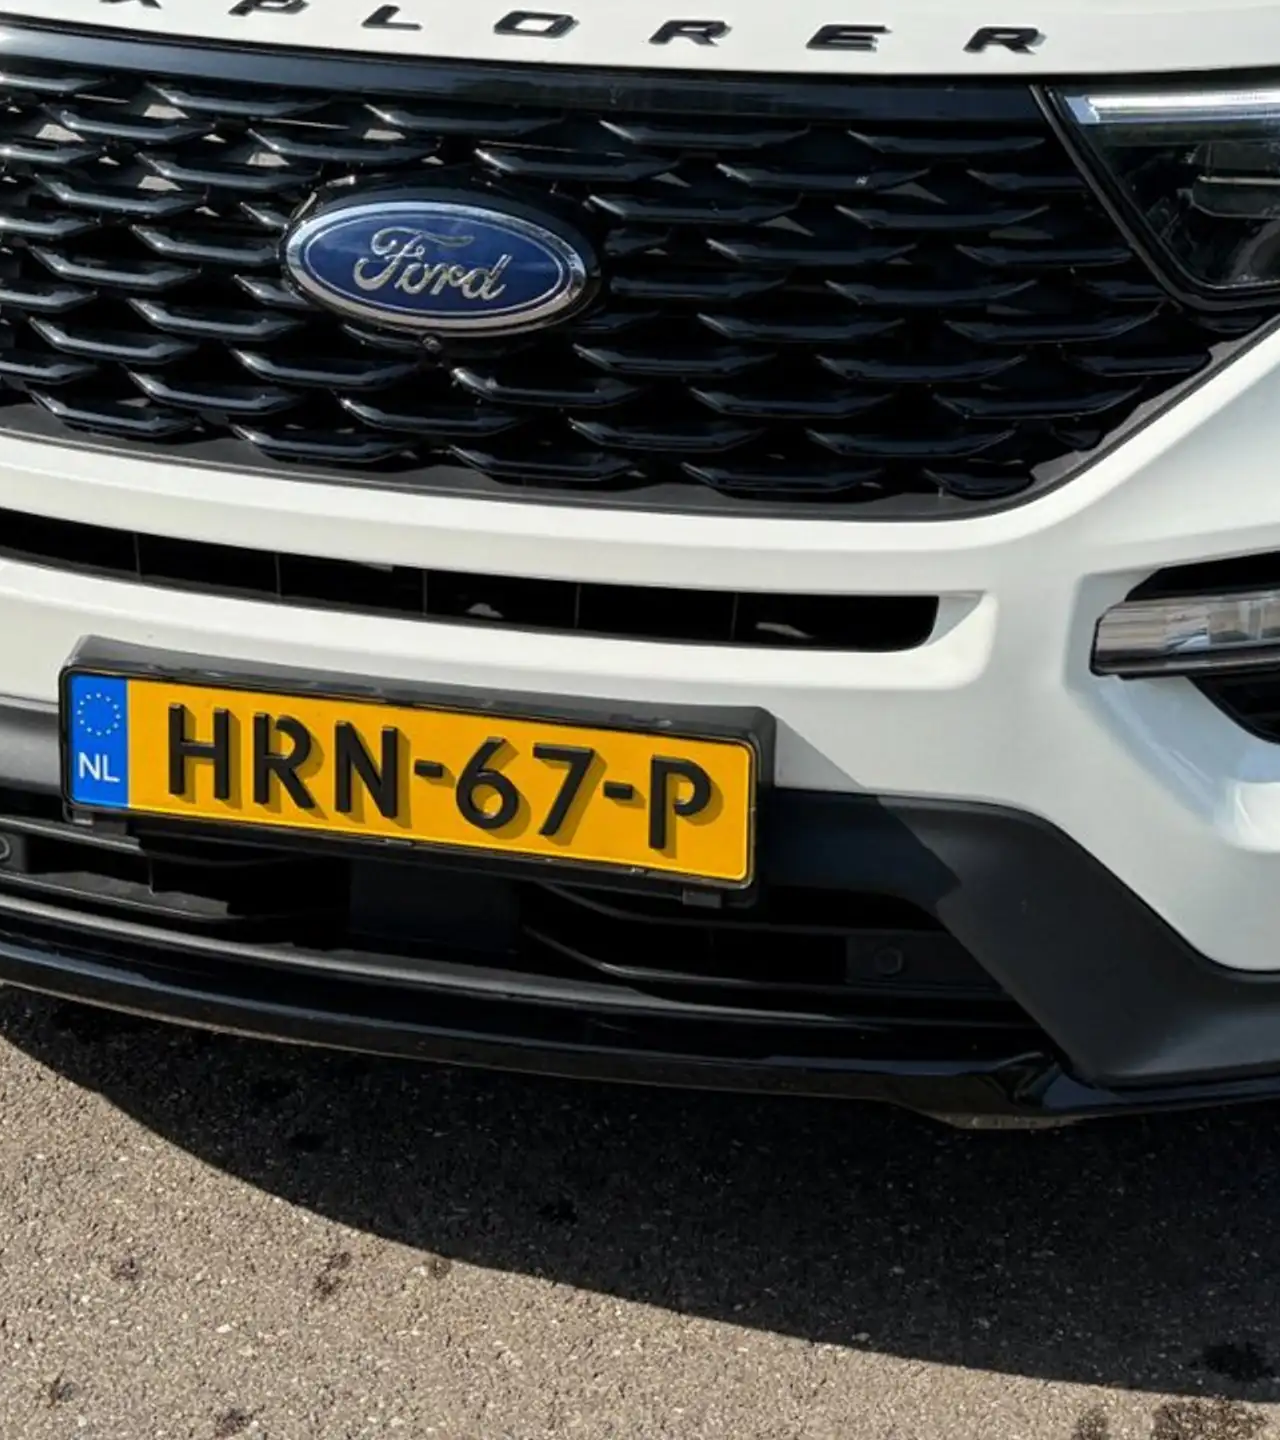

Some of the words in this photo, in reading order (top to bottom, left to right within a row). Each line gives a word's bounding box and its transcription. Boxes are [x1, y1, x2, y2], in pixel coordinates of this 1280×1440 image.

[352, 225, 513, 301] Ford
[78, 752, 120, 783] NL
[167, 703, 713, 851] HRN-67-P
